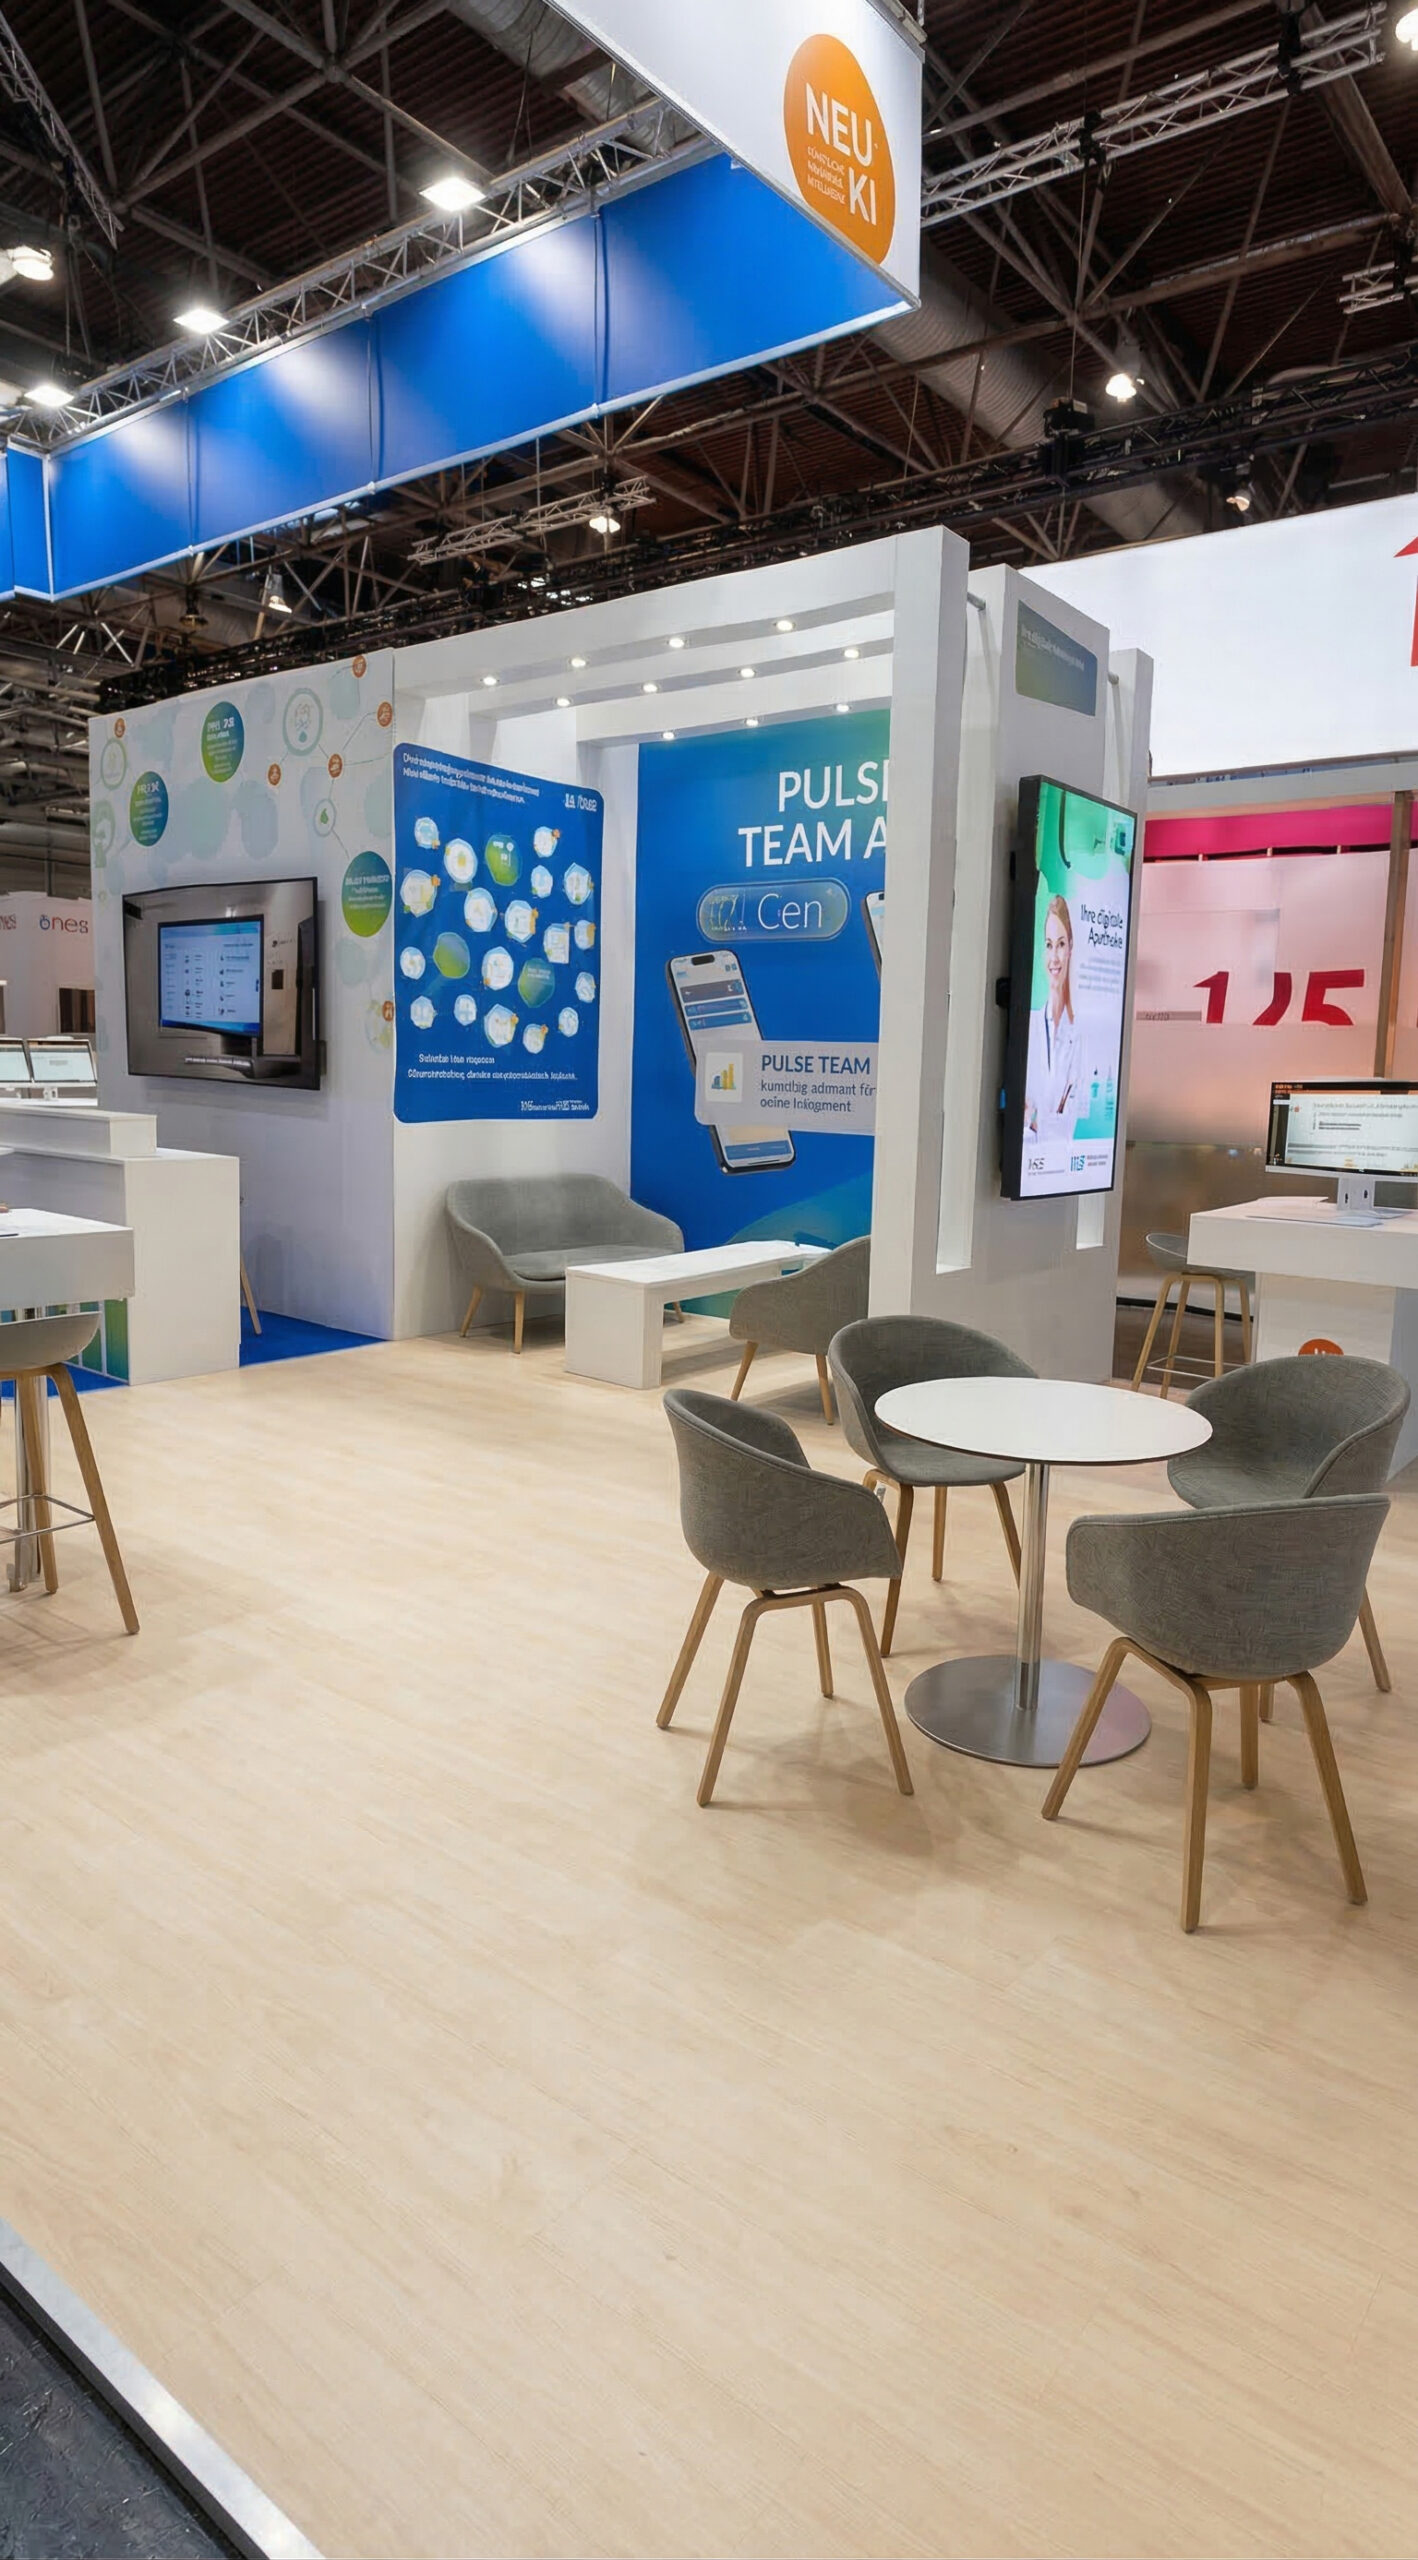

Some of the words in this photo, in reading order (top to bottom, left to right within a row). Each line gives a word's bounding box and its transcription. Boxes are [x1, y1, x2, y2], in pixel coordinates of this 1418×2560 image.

[849, 167, 877, 226] KI
[738, 819, 852, 868] TEAM
[761, 1054, 814, 1074] PULSE
[818, 1056, 871, 1075] TEAM
